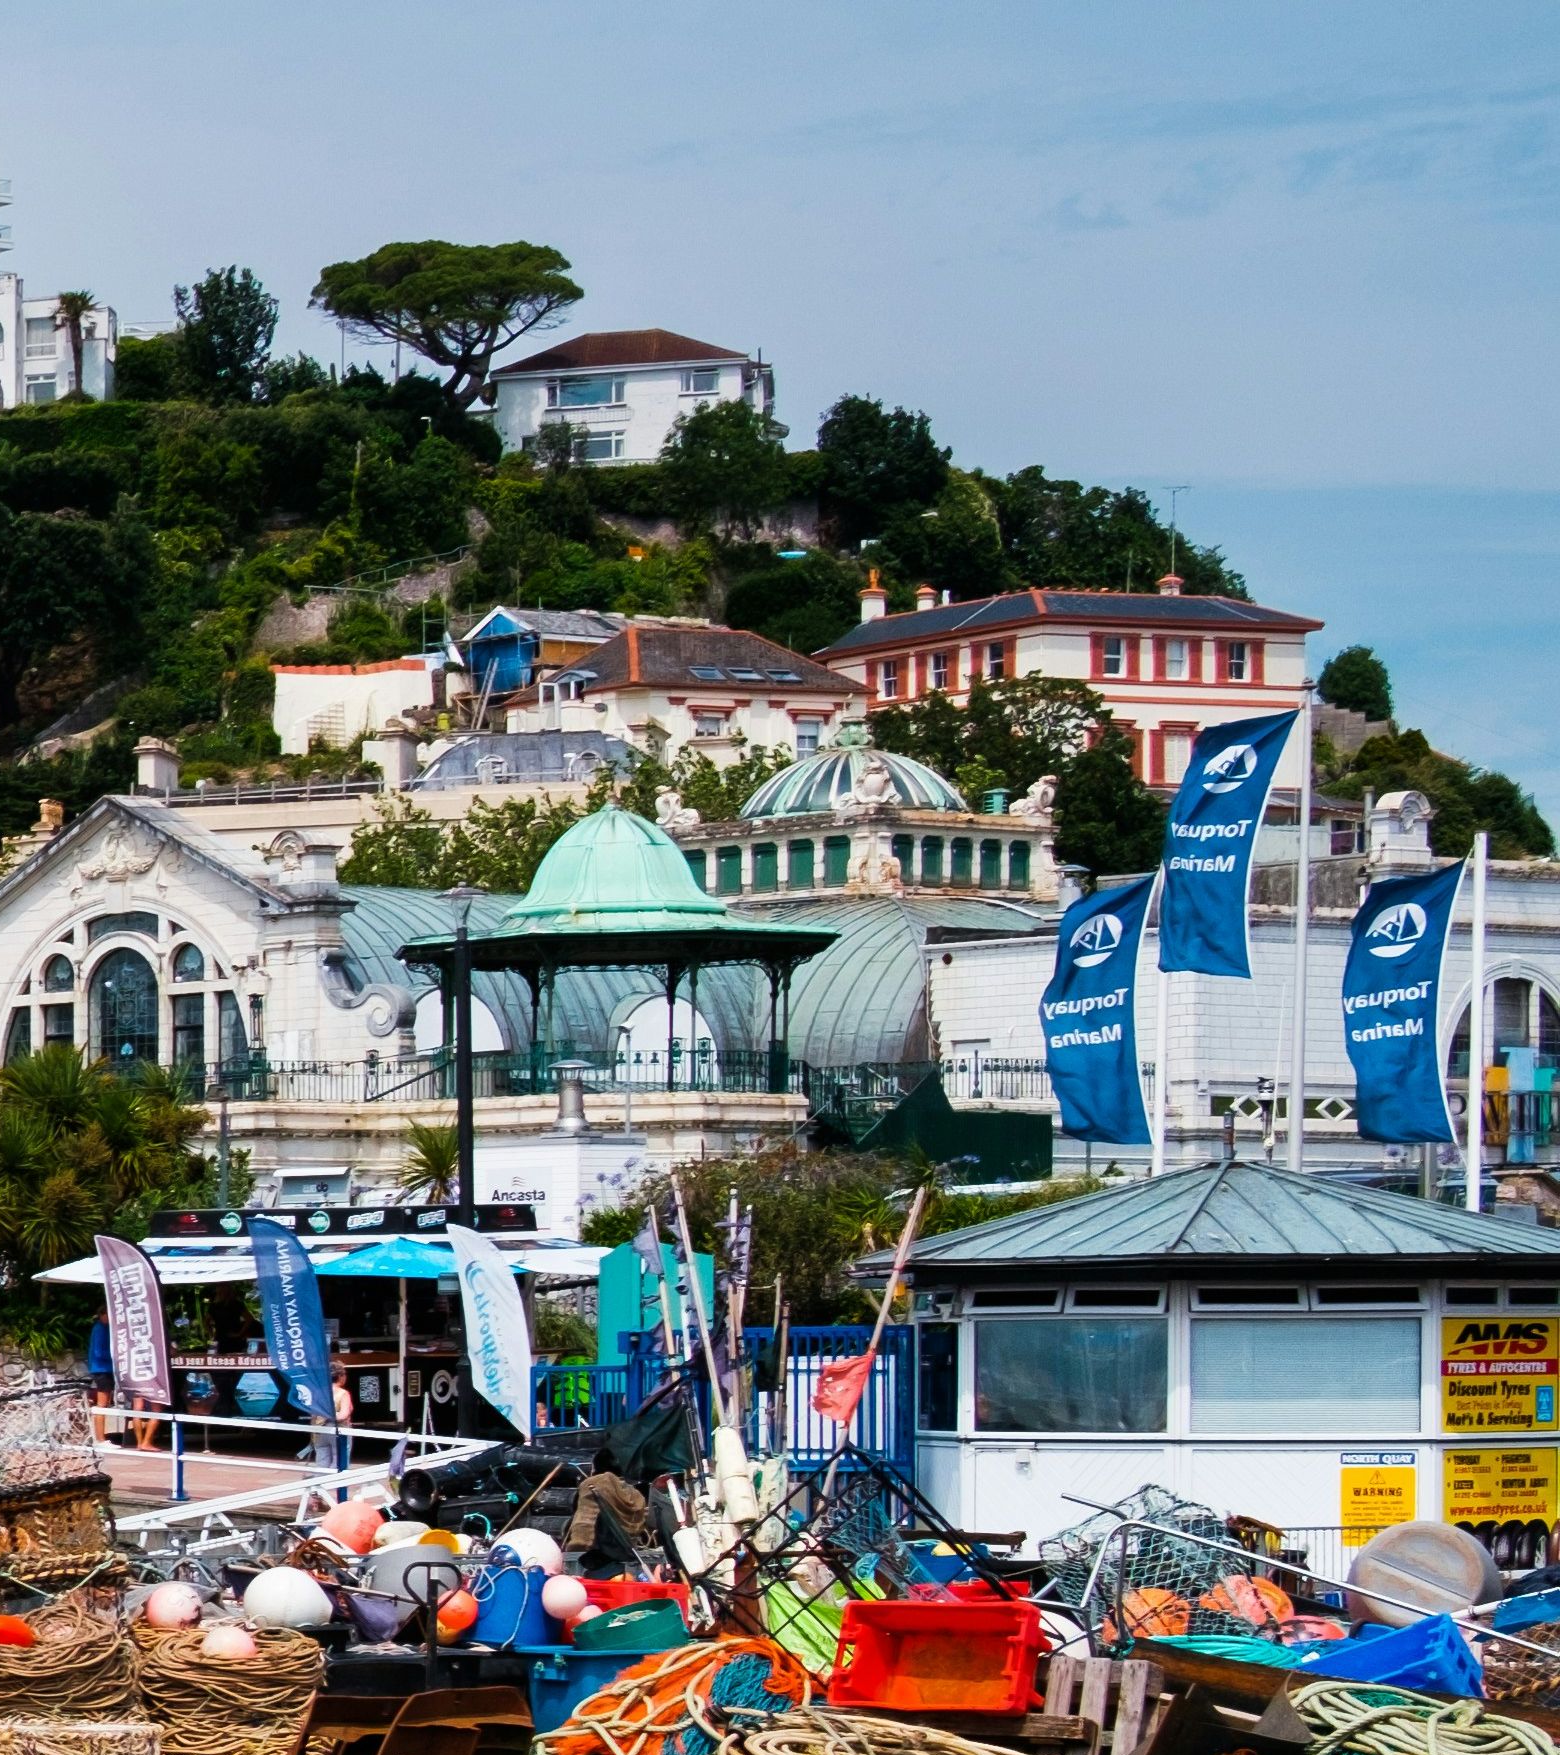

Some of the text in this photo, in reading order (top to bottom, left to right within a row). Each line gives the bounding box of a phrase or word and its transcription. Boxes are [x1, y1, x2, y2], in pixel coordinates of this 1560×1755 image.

[491, 1189, 546, 1202] Ancasta
[1447, 1323, 1550, 1356] AMS
[1448, 1380, 1531, 1400] Discount Tyres
[1476, 1412, 1485, 1425] &
[1487, 1411, 1534, 1428] Servicing
[1342, 1454, 1412, 1465] NORTH QUAY
[1353, 1487, 1403, 1497] WARNING
